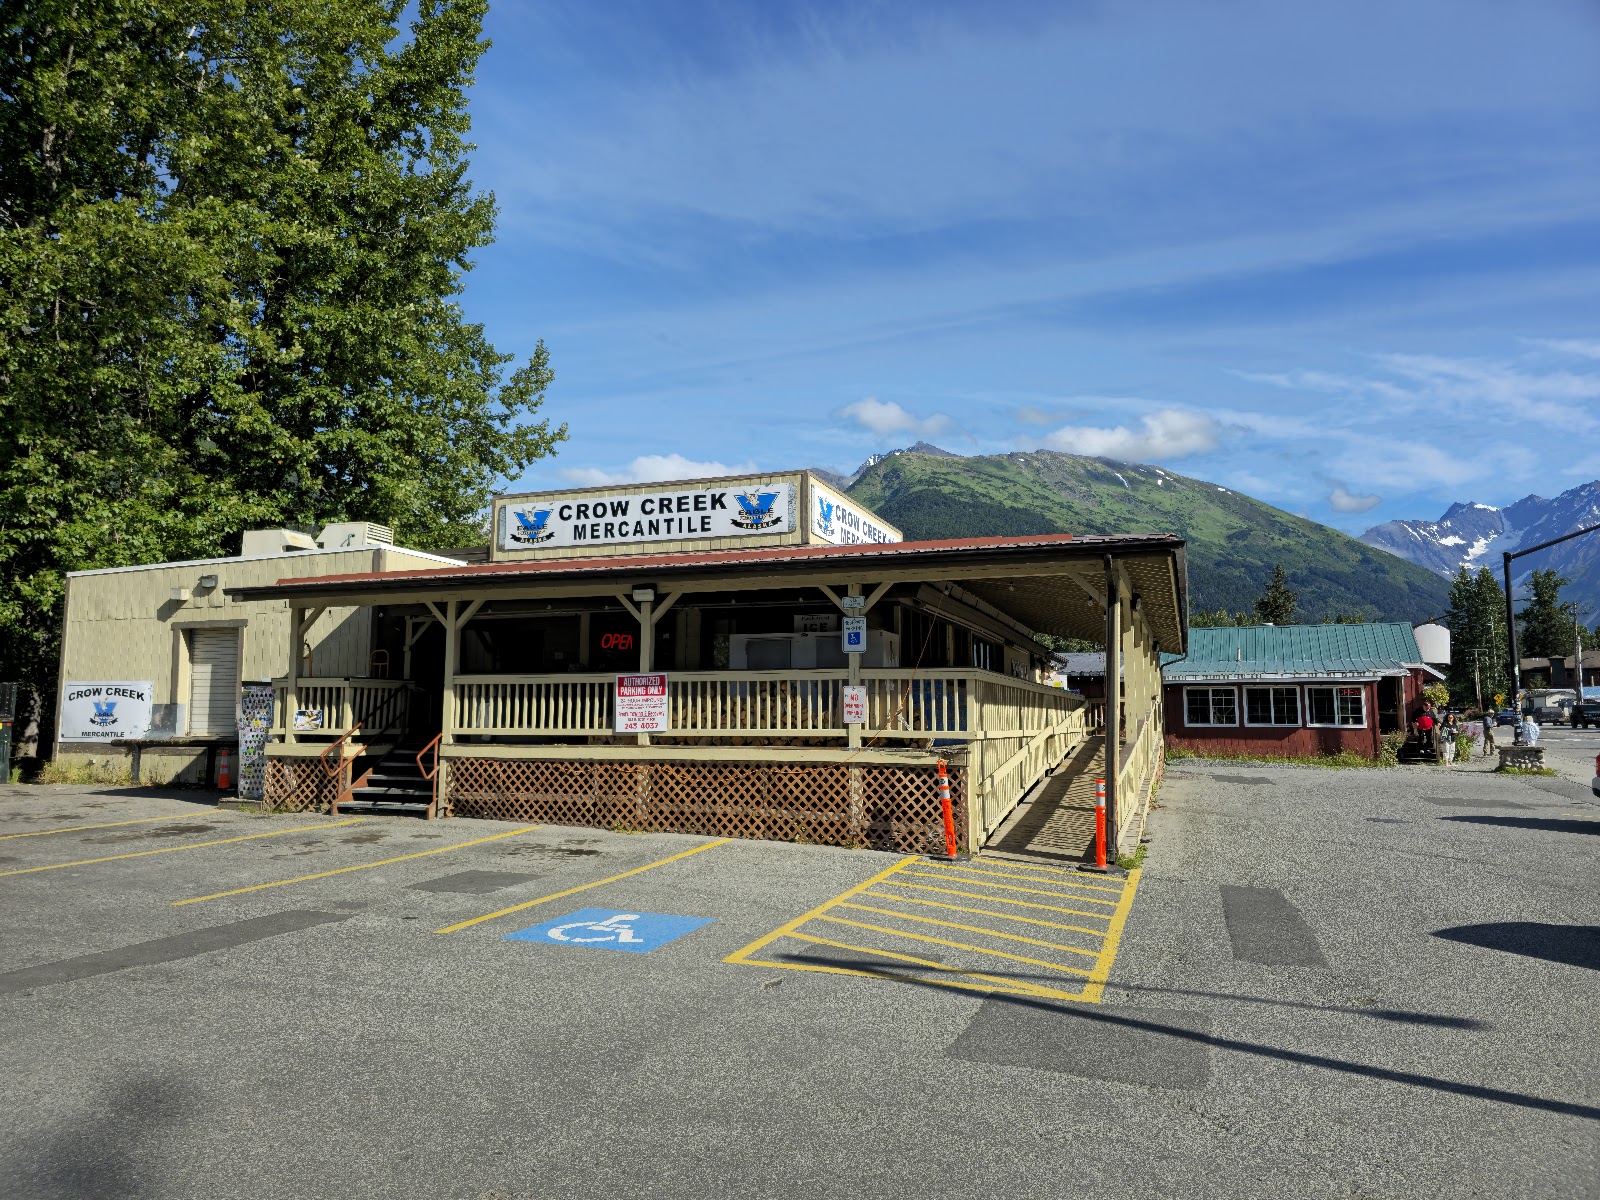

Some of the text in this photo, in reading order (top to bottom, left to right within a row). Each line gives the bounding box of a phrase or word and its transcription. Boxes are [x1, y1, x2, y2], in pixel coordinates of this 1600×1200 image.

[558, 492, 727, 521] CROW CREEK
[738, 507, 774, 516] EAGLE
[517, 523, 548, 531] EAGLE
[573, 515, 712, 541] MERCANTILE
[742, 521, 773, 529] ALASKA
[835, 504, 860, 533] CROW
[862, 520, 887, 544] CREEK
[803, 622, 828, 632] ICE
[601, 633, 633, 649] OPEN
[623, 676, 660, 686] AUTHORIZED
[68, 687, 145, 702] CROW CREEK
[620, 685, 663, 696] PARKING ONLY
